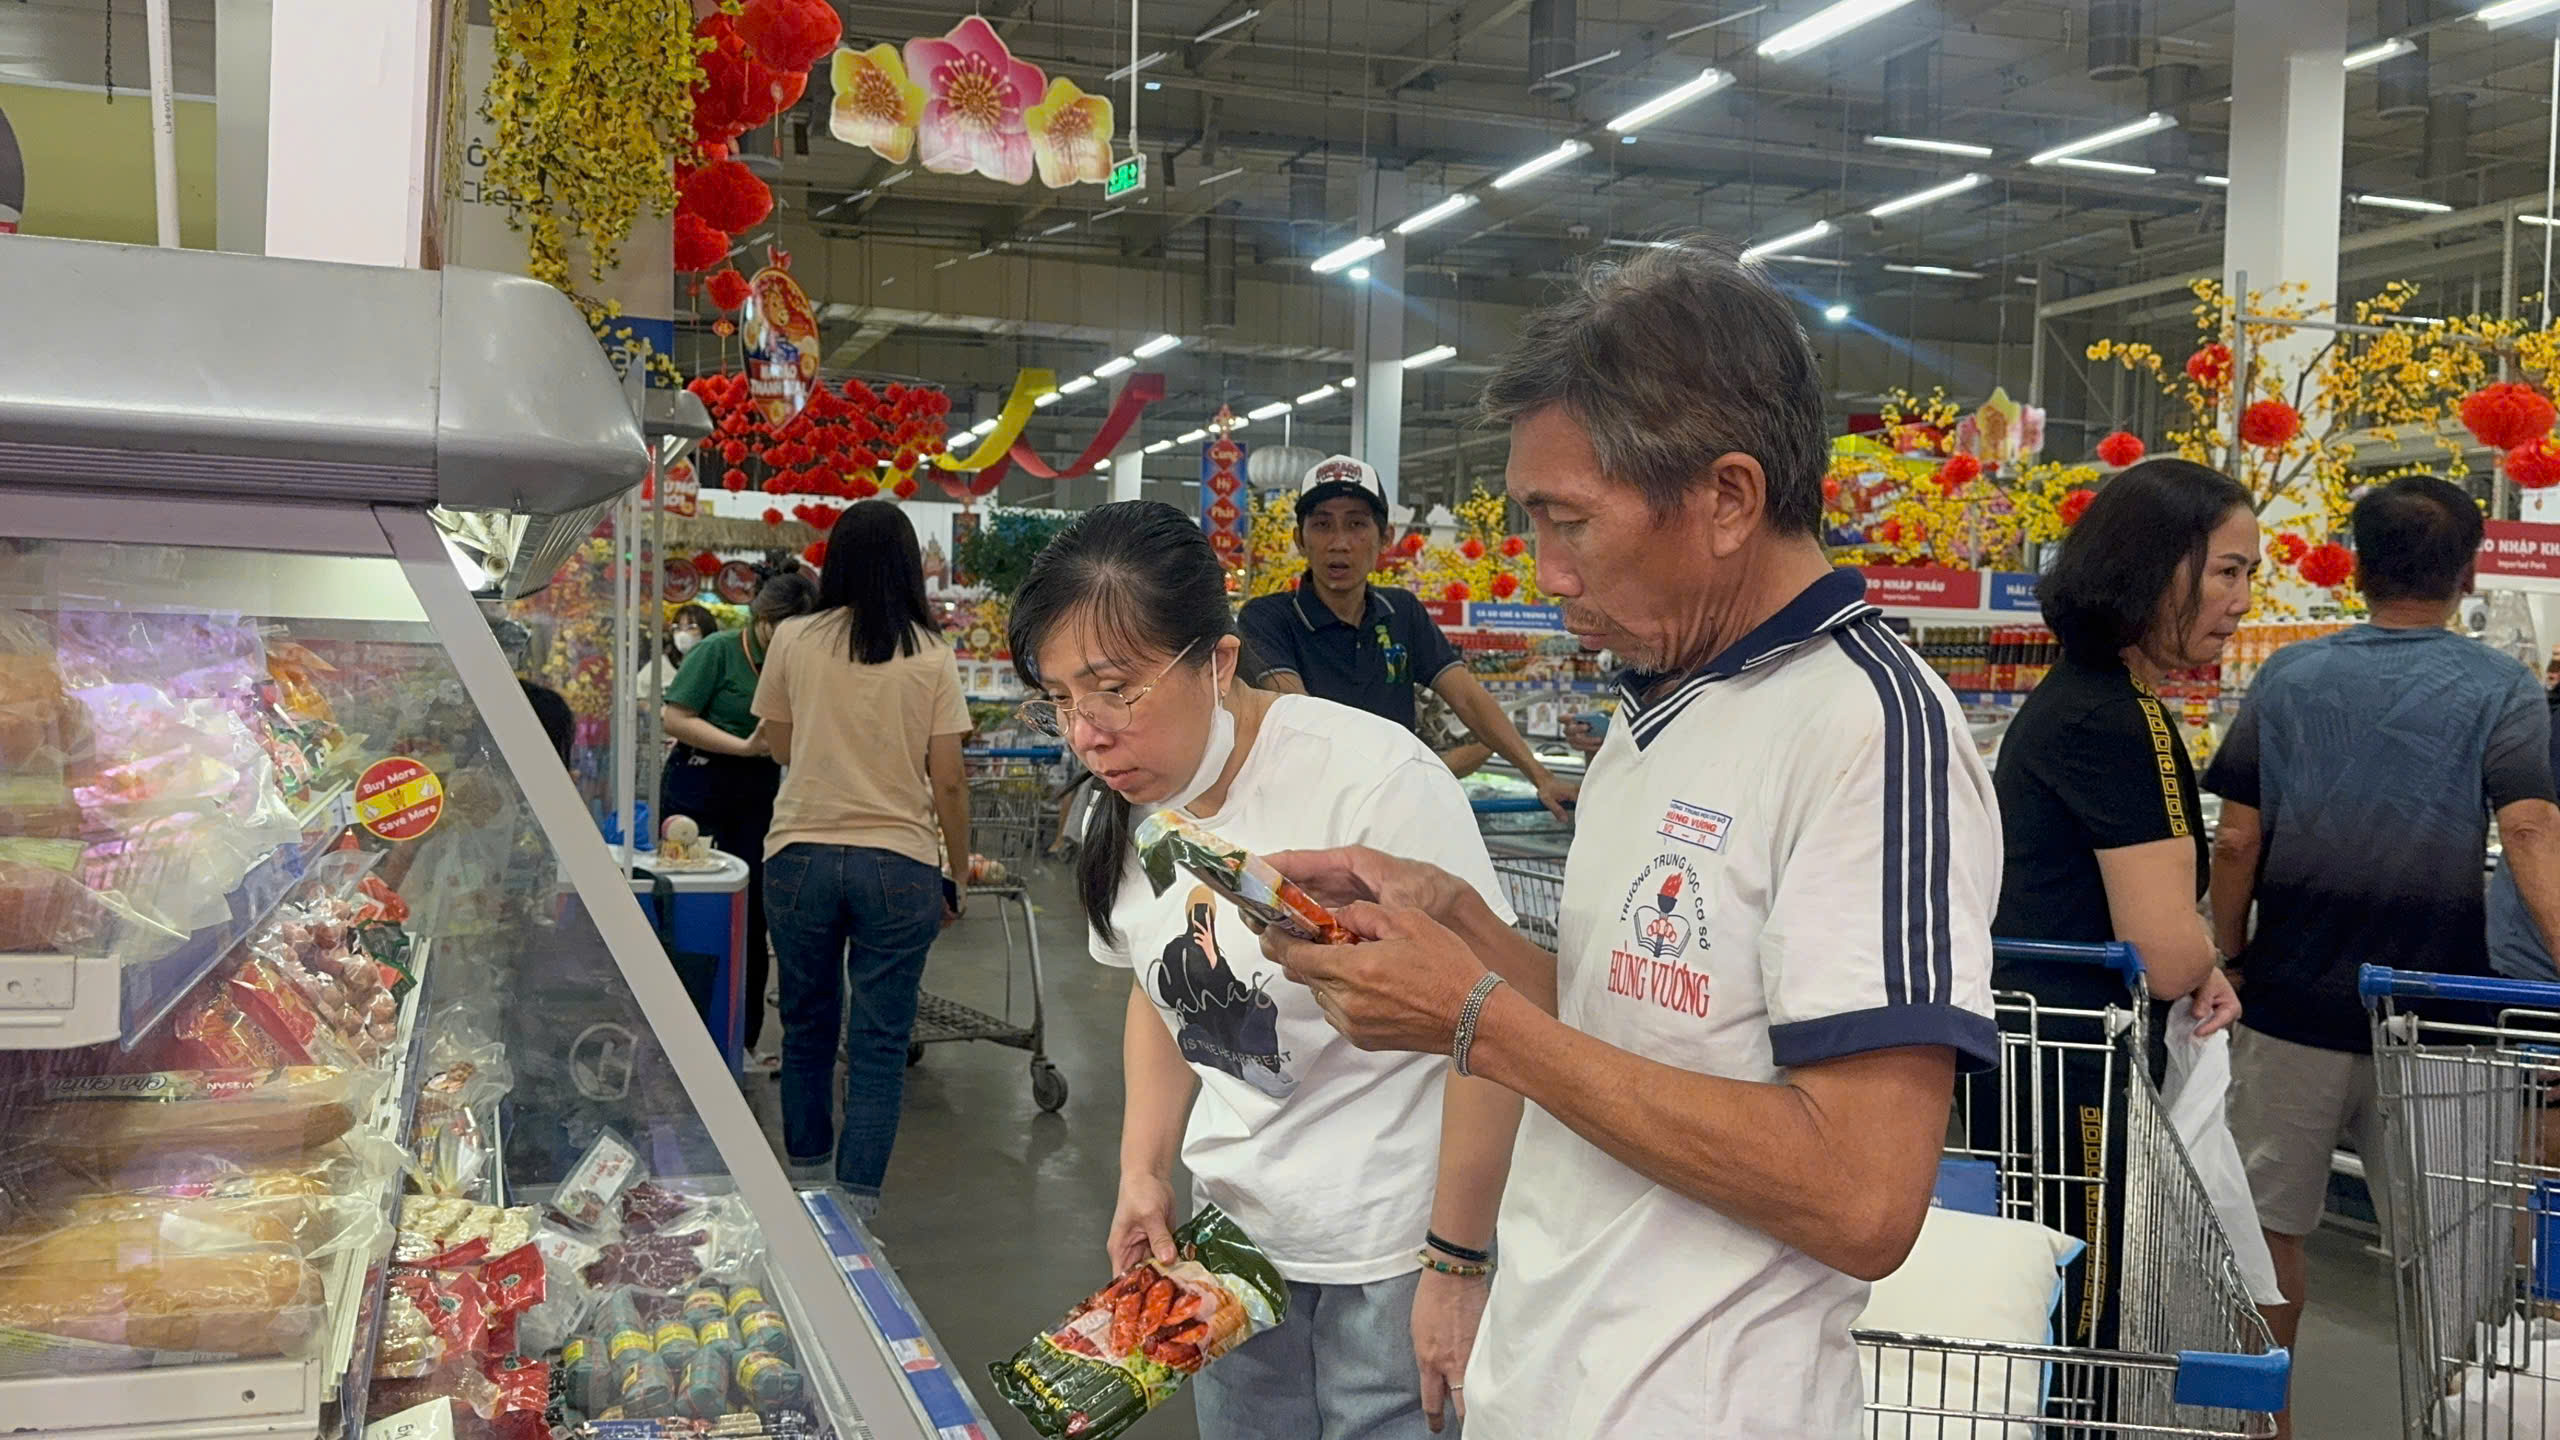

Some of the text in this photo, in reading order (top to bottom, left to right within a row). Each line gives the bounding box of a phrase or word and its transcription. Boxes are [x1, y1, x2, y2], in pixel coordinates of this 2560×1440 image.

[363, 767, 417, 794] Buy More
[378, 804, 437, 834] Save More
[1653, 853, 1687, 870] TRUNG
[1685, 864, 1700, 894] HỌC
[1607, 939, 1711, 1019] HÙNG VƯƠNG
[1182, 1038, 1197, 1050] IS
[206, 1081, 254, 1091] VISSAN
